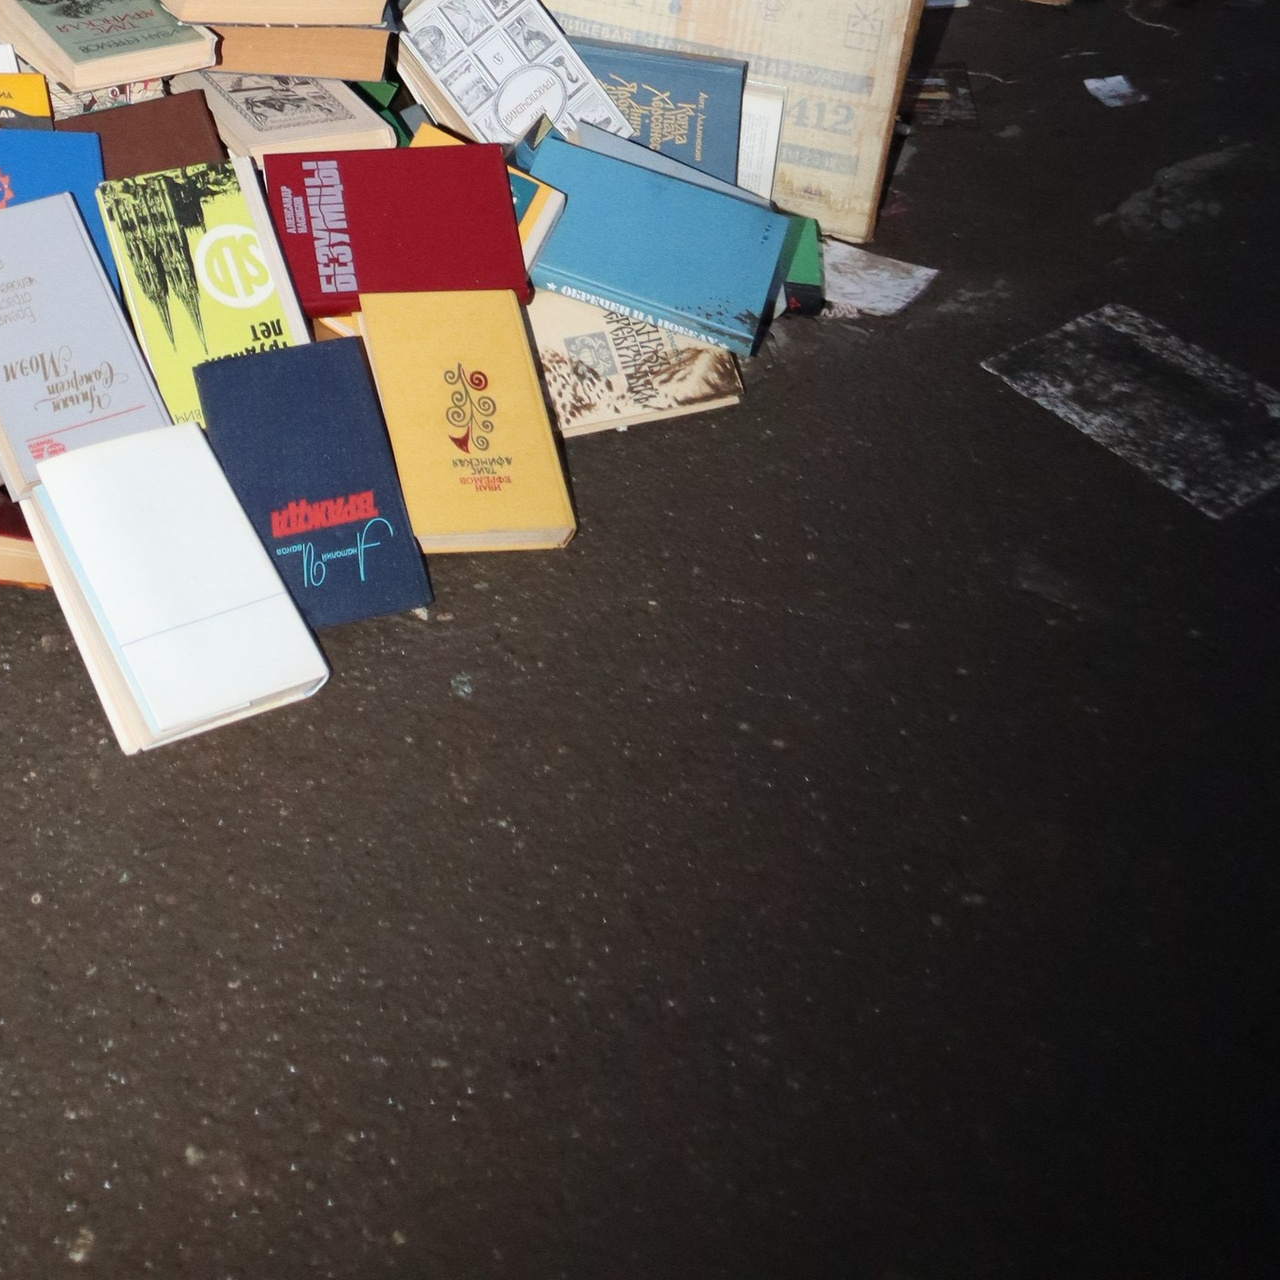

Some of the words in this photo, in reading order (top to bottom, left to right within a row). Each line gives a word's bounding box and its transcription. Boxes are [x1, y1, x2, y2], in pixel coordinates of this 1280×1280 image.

[55, 8, 156, 33] АФИНСКАЯ
[90, 22, 138, 35] ТАИС
[500, 75, 558, 126] ПРИКЛЮЧЕНИЙ
[787, 96, 856, 135] 412
[673, 103, 695, 145] Когда
[281, 185, 295, 233] АЛЕКСАНДР
[294, 195, 306, 233] НАСИБОВ
[302, 159, 357, 293] БЕЗУМЦЫ
[561, 284, 631, 319] ОБРЕЧЕН
[3, 345, 72, 384] Моэм
[45, 357, 130, 397] Сомерсет
[451, 457, 512, 468] АФИНСКАЯ
[459, 476, 511, 485] ЕФРЕМОВ
[470, 467, 497, 475] ТАИС
[270, 491, 378, 538] ВРАЖДА
[276, 539, 327, 588] Иванов
[323, 518, 394, 583] Анатолий
